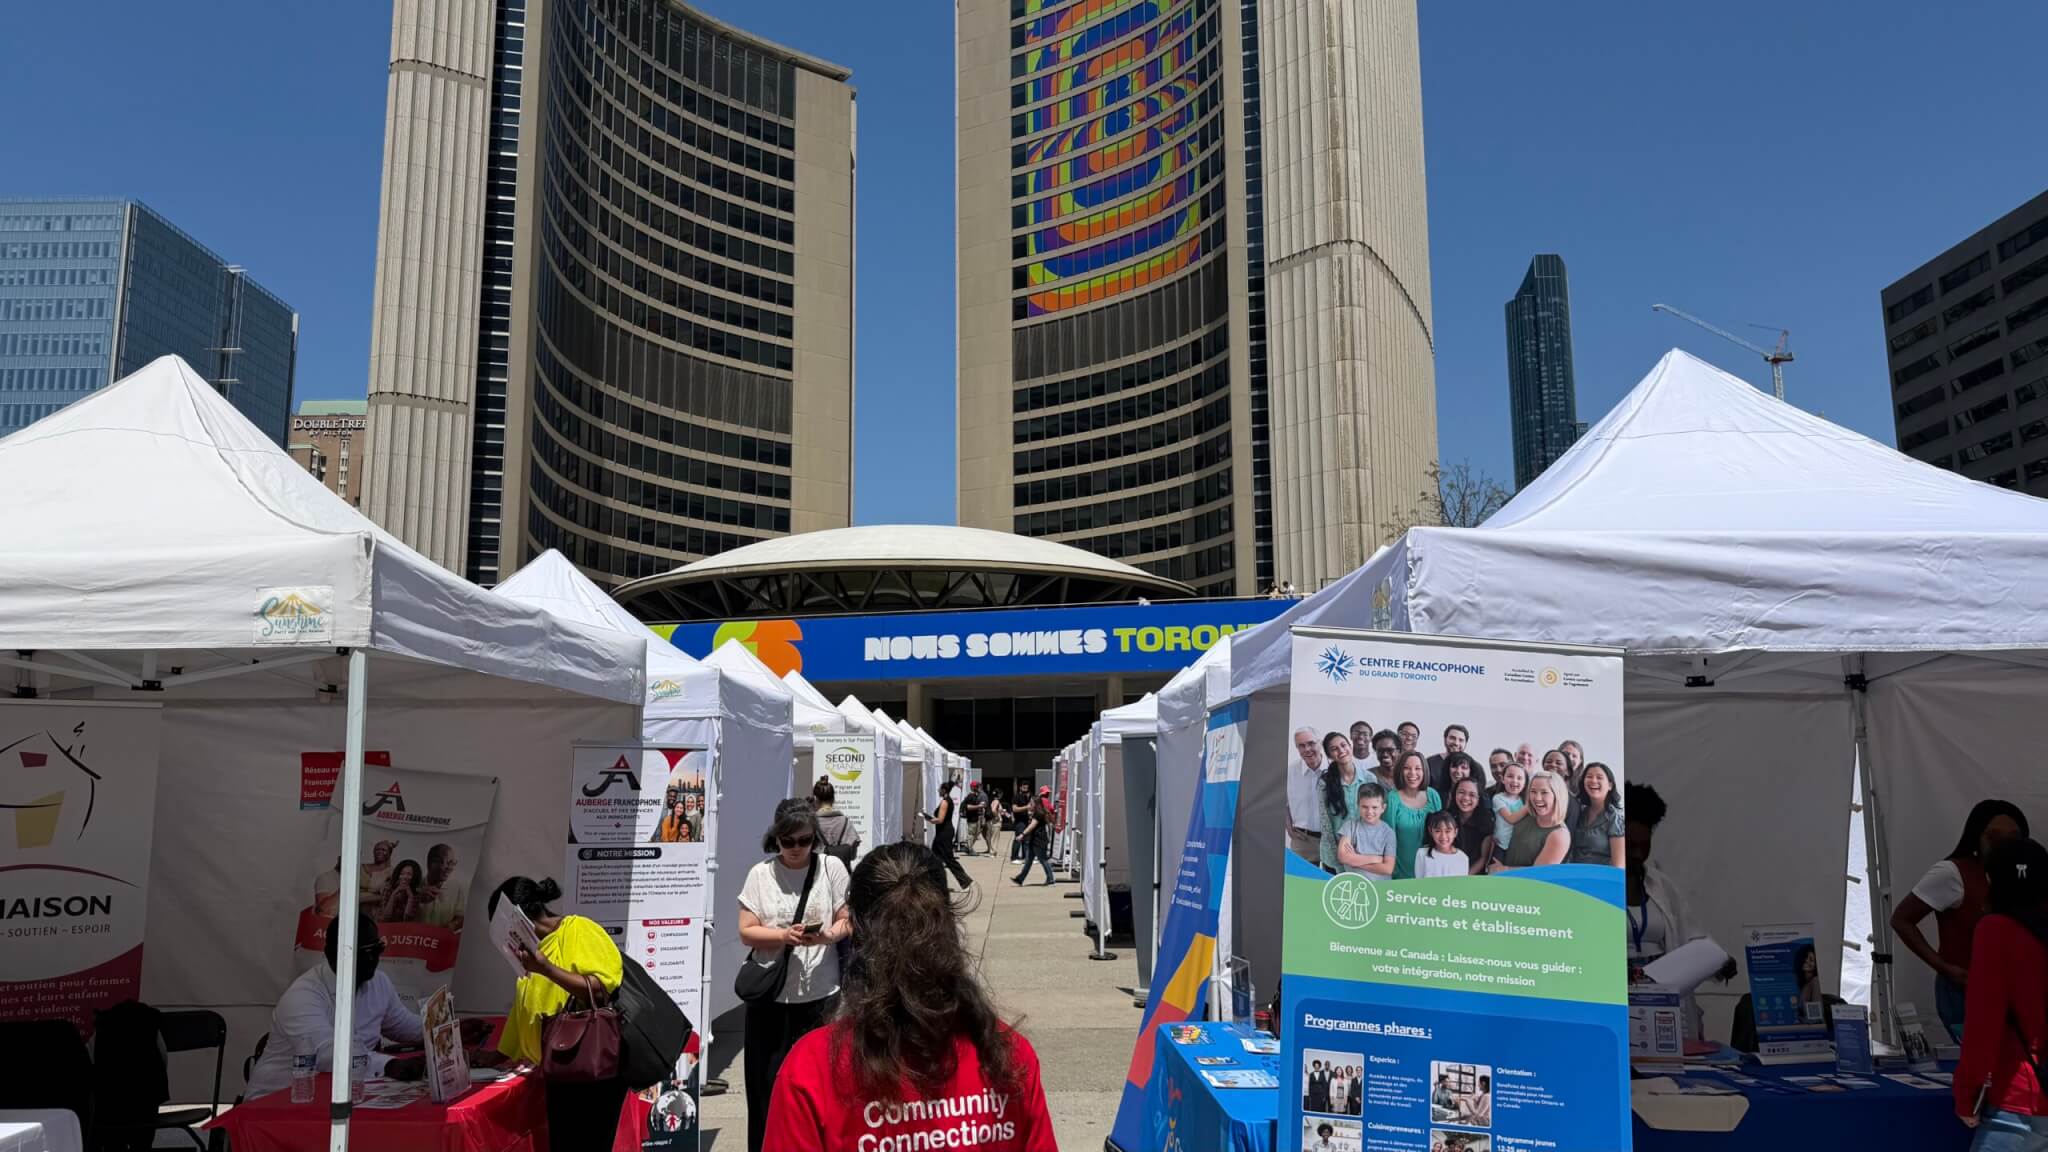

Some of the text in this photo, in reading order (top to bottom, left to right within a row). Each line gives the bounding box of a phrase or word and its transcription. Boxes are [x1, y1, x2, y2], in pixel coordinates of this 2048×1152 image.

[259, 597, 328, 637] Sunshine
[864, 623, 1258, 661] NOUS SOMMES TORO
[1359, 657, 1485, 675] CENTRE FRANCOPHONE
[1371, 670, 1399, 679] GRAND
[1400, 672, 1438, 682] TORONTO
[825, 754, 865, 763] SECOND
[576, 798, 661, 806] AUBERGE FRANCOPHONE
[376, 810, 451, 826] AUBERGE FRANCOPHONE
[624, 849, 655, 857] MISSION
[1385, 889, 1541, 916] Service des nouveaux
[7, 926, 57, 938] SOUTIEN
[72, 923, 111, 935] ESPOIR
[1385, 912, 1574, 940] arrivants et établissement
[390, 935, 440, 949] JUSTICE
[1329, 941, 1383, 956] Bienvenue
[1384, 949, 1398, 957] au
[1400, 948, 1439, 962] Canada
[1447, 952, 1513, 969] Laissez-nous
[1514, 960, 1540, 970] vous
[1541, 962, 1577, 974] guider
[1371, 963, 1536, 987] votre intégration, notre mission
[14, 981, 56, 991] soutien
[59, 979, 85, 993] pour
[88, 976, 131, 986] femmes
[23, 994, 33, 1003] et
[37, 992, 65, 1002] leurs
[67, 989, 109, 999] enfants
[17, 1005, 31, 1016] de
[34, 1002, 81, 1014] violence
[1304, 1012, 1381, 1034] Programmes
[1383, 1020, 1425, 1037] phares
[1496, 1067, 1532, 1077] Orientation
[863, 1088, 1009, 1129] Community
[857, 1120, 1016, 1152] Connections
[1496, 1134, 1557, 1148] Programme jeunes
